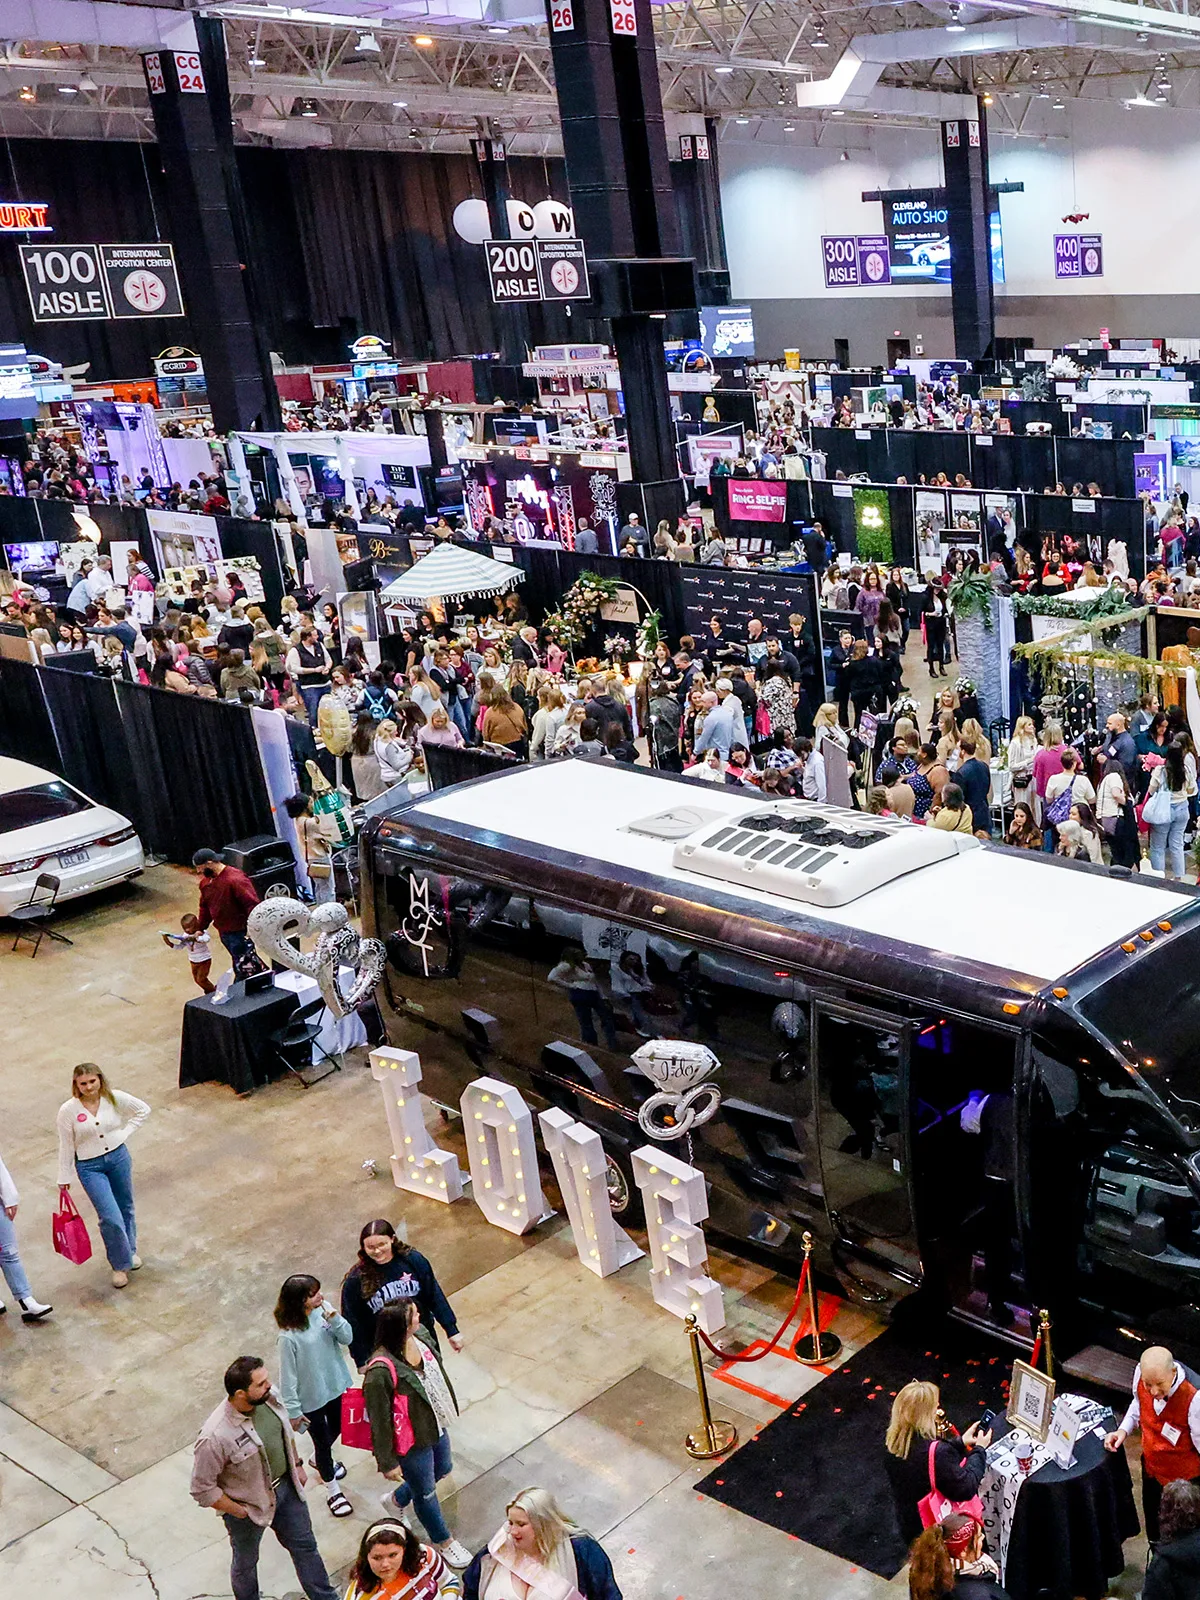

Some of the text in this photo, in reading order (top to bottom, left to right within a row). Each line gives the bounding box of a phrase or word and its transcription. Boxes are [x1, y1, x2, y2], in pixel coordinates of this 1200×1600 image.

[553, 8, 572, 27] 26
[613, 12, 635, 31] 26
[177, 56, 199, 69] CC
[150, 76, 163, 90] 24
[179, 75, 203, 89] 24
[949, 124, 955, 132] Y
[947, 136, 958, 145] 24
[970, 136, 980, 145] 24
[682, 149, 692, 157] 22
[698, 148, 708, 157] 22
[892, 201, 927, 210] CLEVELAND
[892, 210, 949, 225] AUTO SHO
[112, 250, 163, 258] INTERNATIONAL
[825, 240, 854, 262] 300
[1057, 238, 1078, 257] 400
[106, 259, 173, 268] EXPOSITION CENTER
[490, 246, 534, 272] 200
[27, 251, 96, 284] 100
[829, 267, 857, 282] AISLE
[1058, 261, 1079, 274] AISLE
[496, 279, 539, 297] AISLE
[39, 291, 104, 315] AISLE
[732, 493, 786, 506] RING SELFIE
[367, 1291, 384, 1315] LOS
[349, 1408, 404, 1435] LE
